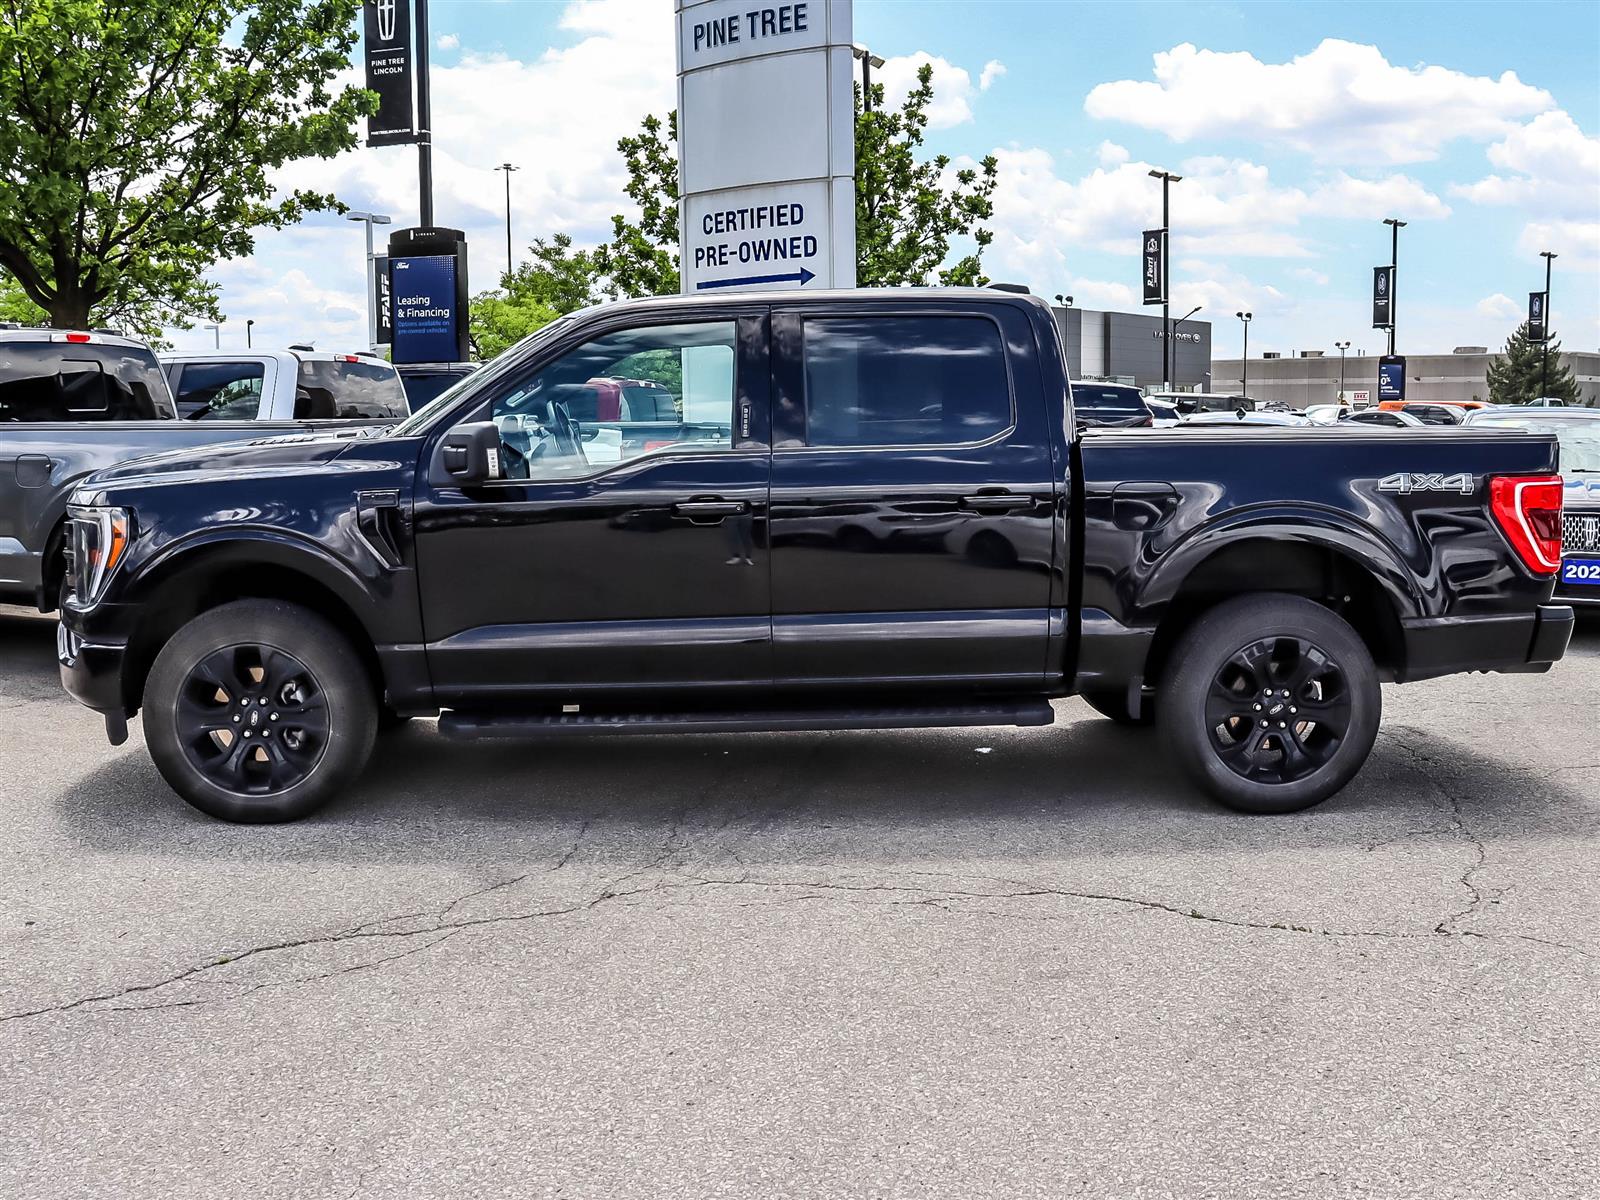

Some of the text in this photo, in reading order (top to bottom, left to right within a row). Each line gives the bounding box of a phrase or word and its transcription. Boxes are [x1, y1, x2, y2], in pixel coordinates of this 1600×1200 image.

[694, 3, 808, 51] PINE TREE
[373, 66, 403, 75] LINCOLN
[703, 203, 804, 235] CERTIFIED
[695, 235, 818, 268] PRE-OWNED
[381, 274, 390, 328] PFAFF
[397, 295, 430, 306] Leasing
[397, 307, 450, 319] & Financing
[1173, 332, 1192, 341] OVER
